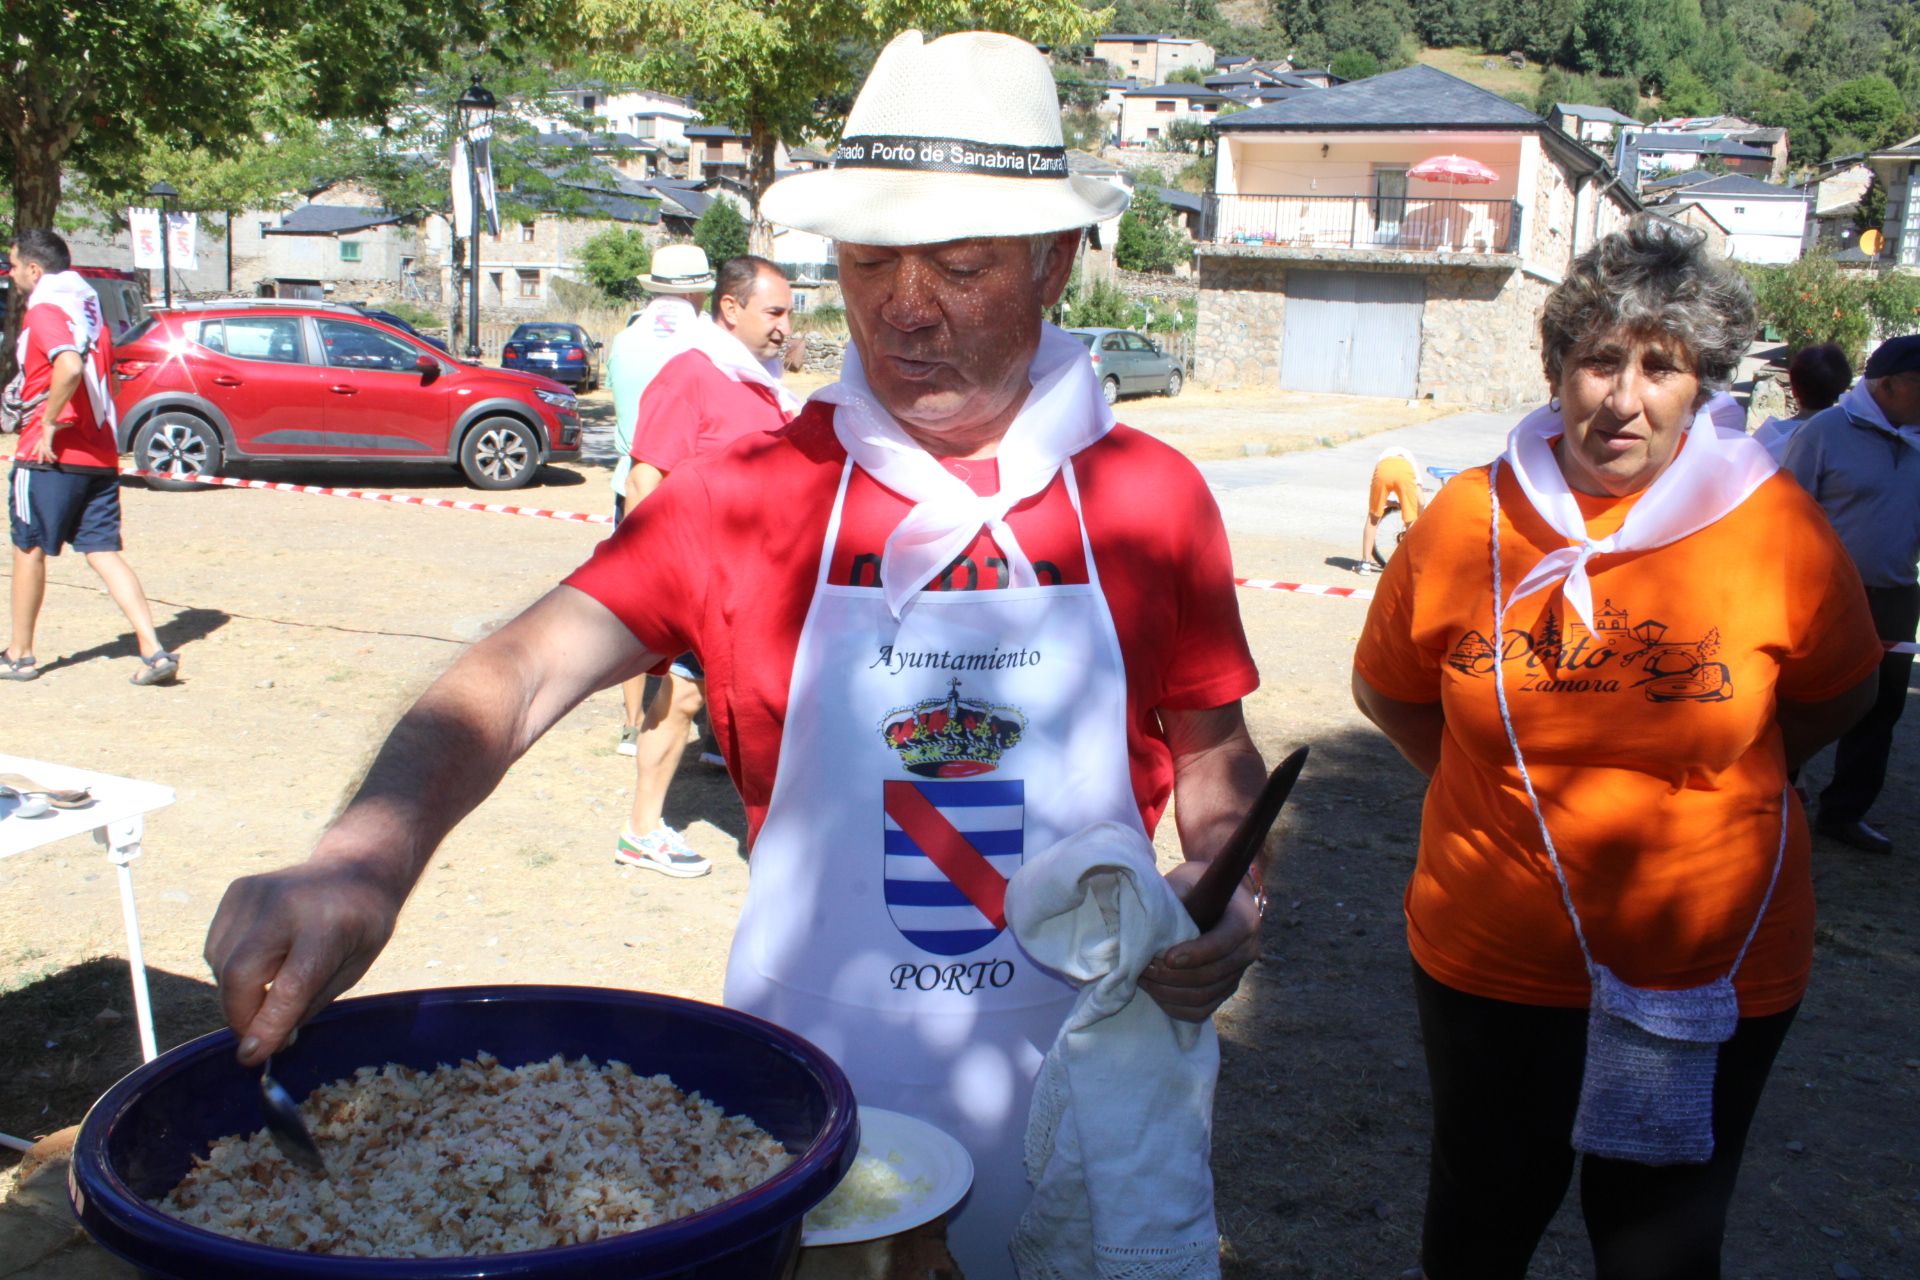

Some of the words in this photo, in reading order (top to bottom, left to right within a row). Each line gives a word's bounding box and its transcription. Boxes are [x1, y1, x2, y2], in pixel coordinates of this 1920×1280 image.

[871, 142, 915, 161] Porto
[920, 146, 944, 162] de
[951, 147, 1024, 170] Sanabria
[869, 644, 1041, 675] Ayuntamiento
[1473, 628, 1620, 671] Porto
[1518, 673, 1620, 692] Zamora
[890, 958, 1015, 995] PORTO
